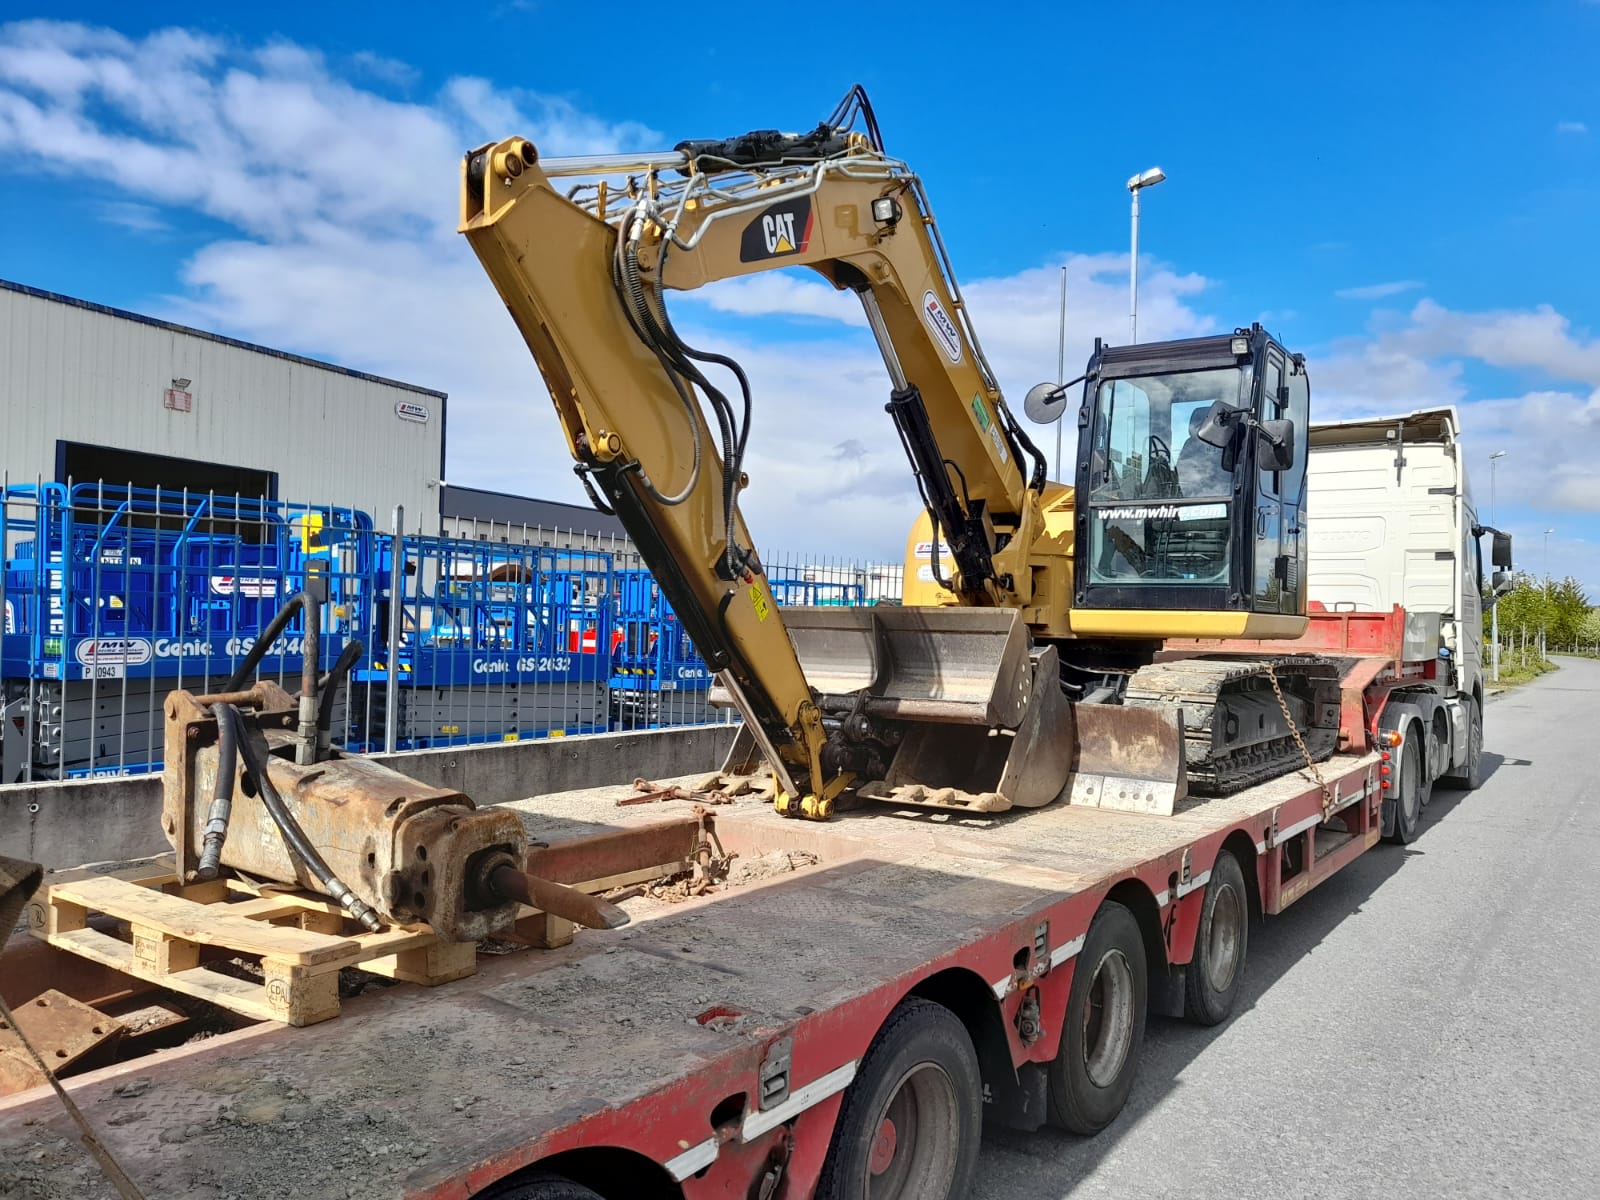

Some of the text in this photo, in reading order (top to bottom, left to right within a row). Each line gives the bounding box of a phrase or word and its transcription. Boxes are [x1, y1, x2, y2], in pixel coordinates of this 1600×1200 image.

[762, 212, 796, 254] CAT
[937, 310, 956, 337] MW
[1098, 504, 1223, 520] www.mwhire.com
[101, 641, 137, 649] MW
[154, 638, 215, 658] Genie
[473, 658, 510, 673] Genie
[678, 666, 704, 678] Gene
